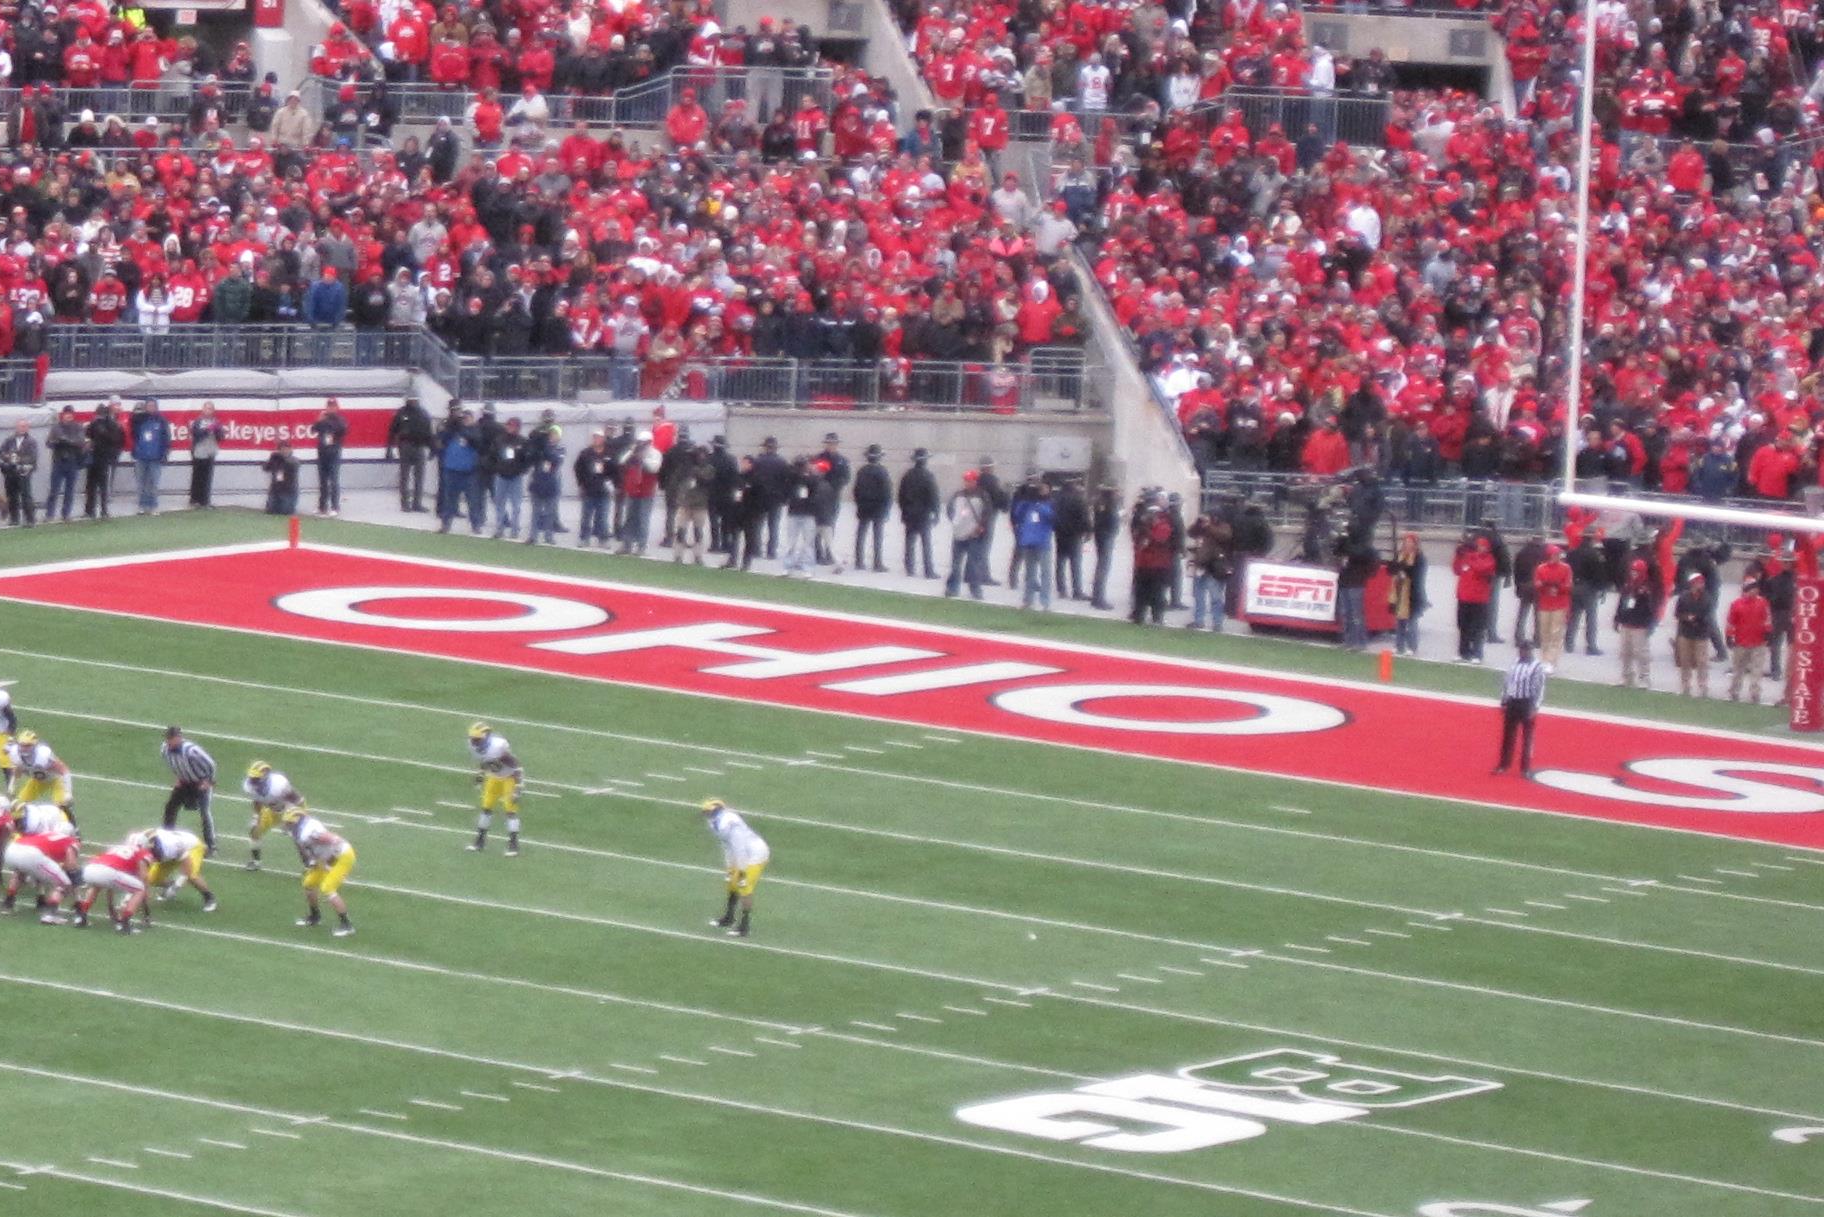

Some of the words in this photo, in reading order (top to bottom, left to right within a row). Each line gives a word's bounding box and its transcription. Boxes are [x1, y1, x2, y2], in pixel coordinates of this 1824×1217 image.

[943, 64, 954, 82] 7
[983, 117, 995, 135] 7
[1257, 574, 1335, 602] ESPN
[1797, 585, 1820, 645] OHIO
[275, 585, 1349, 736] OHIO
[1792, 651, 1813, 725] STATE
